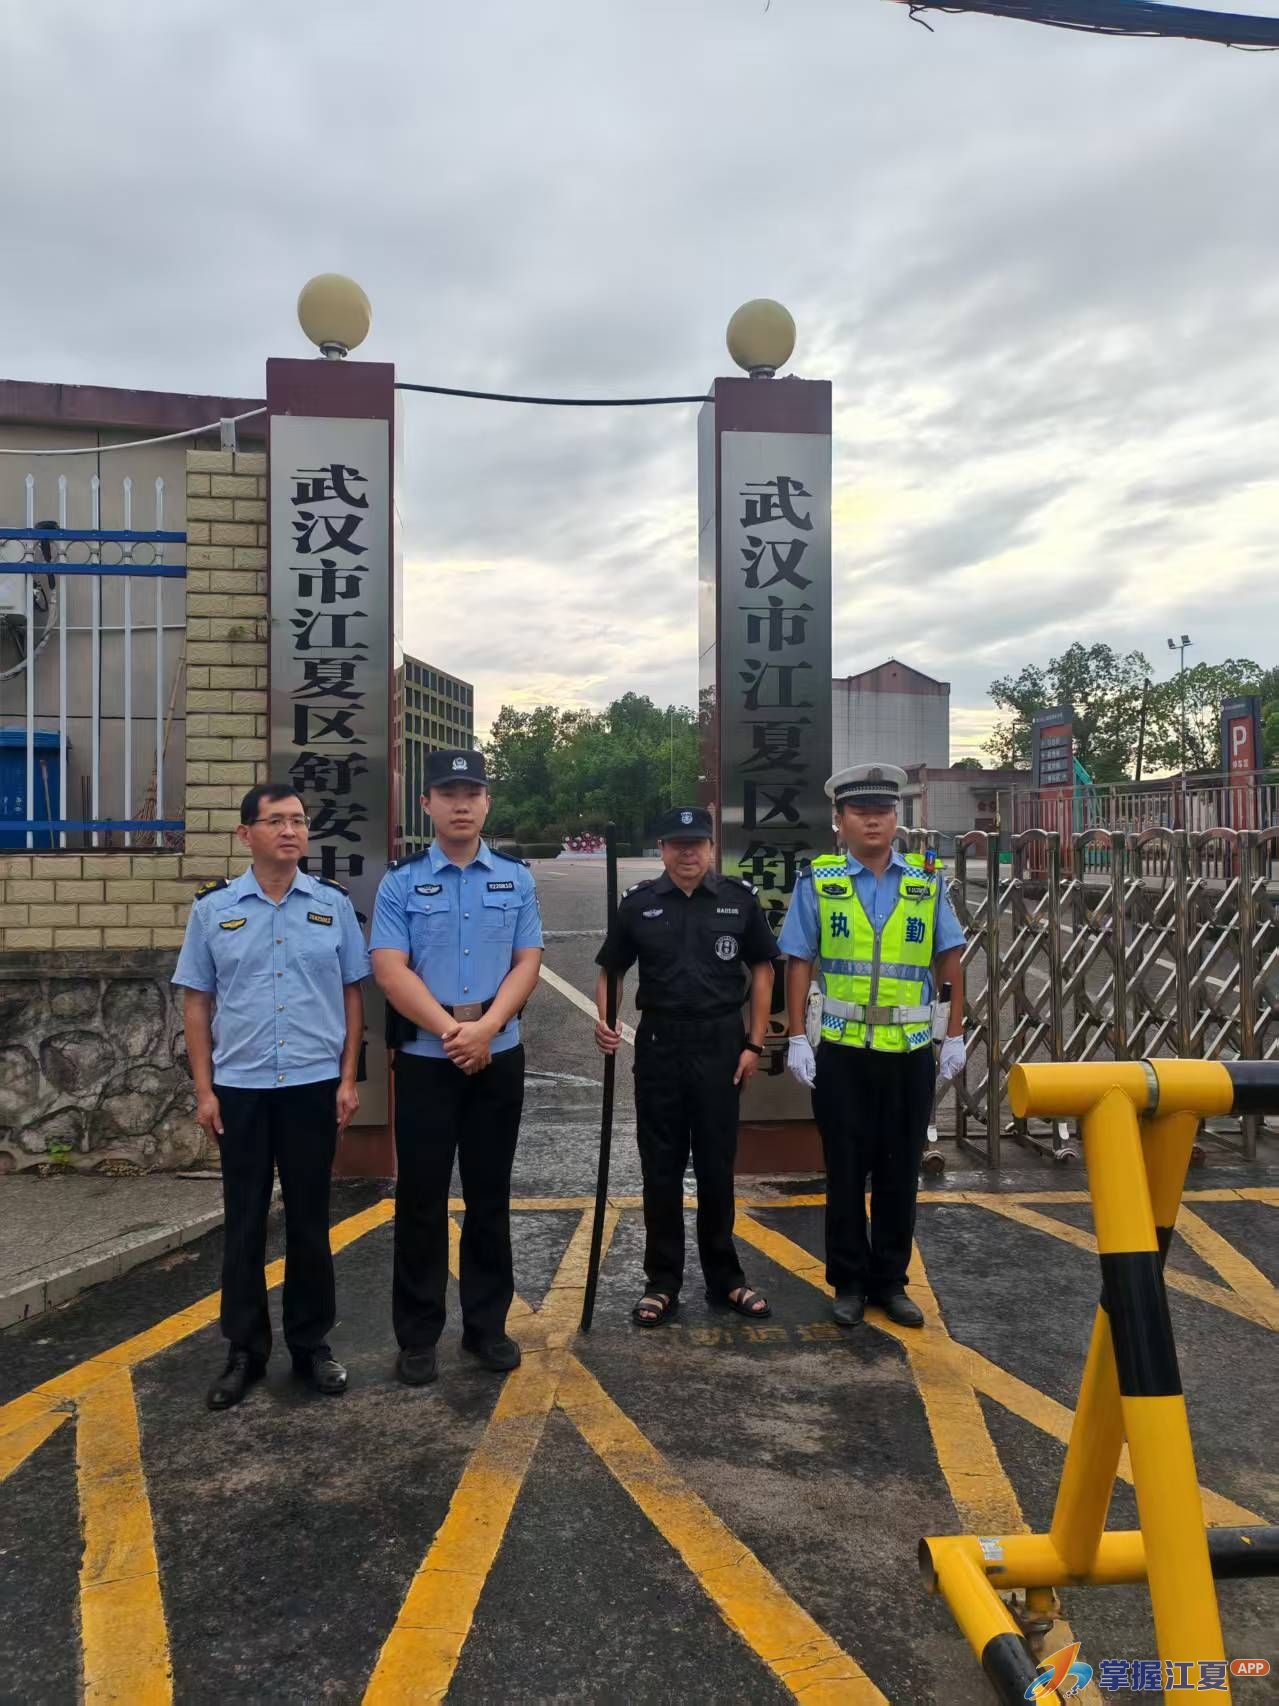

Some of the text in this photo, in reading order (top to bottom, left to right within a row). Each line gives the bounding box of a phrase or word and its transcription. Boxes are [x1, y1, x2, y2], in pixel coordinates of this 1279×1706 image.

[288, 464, 369, 1082] 武汉市江夏区舒安中
[1232, 725, 1247, 757] P
